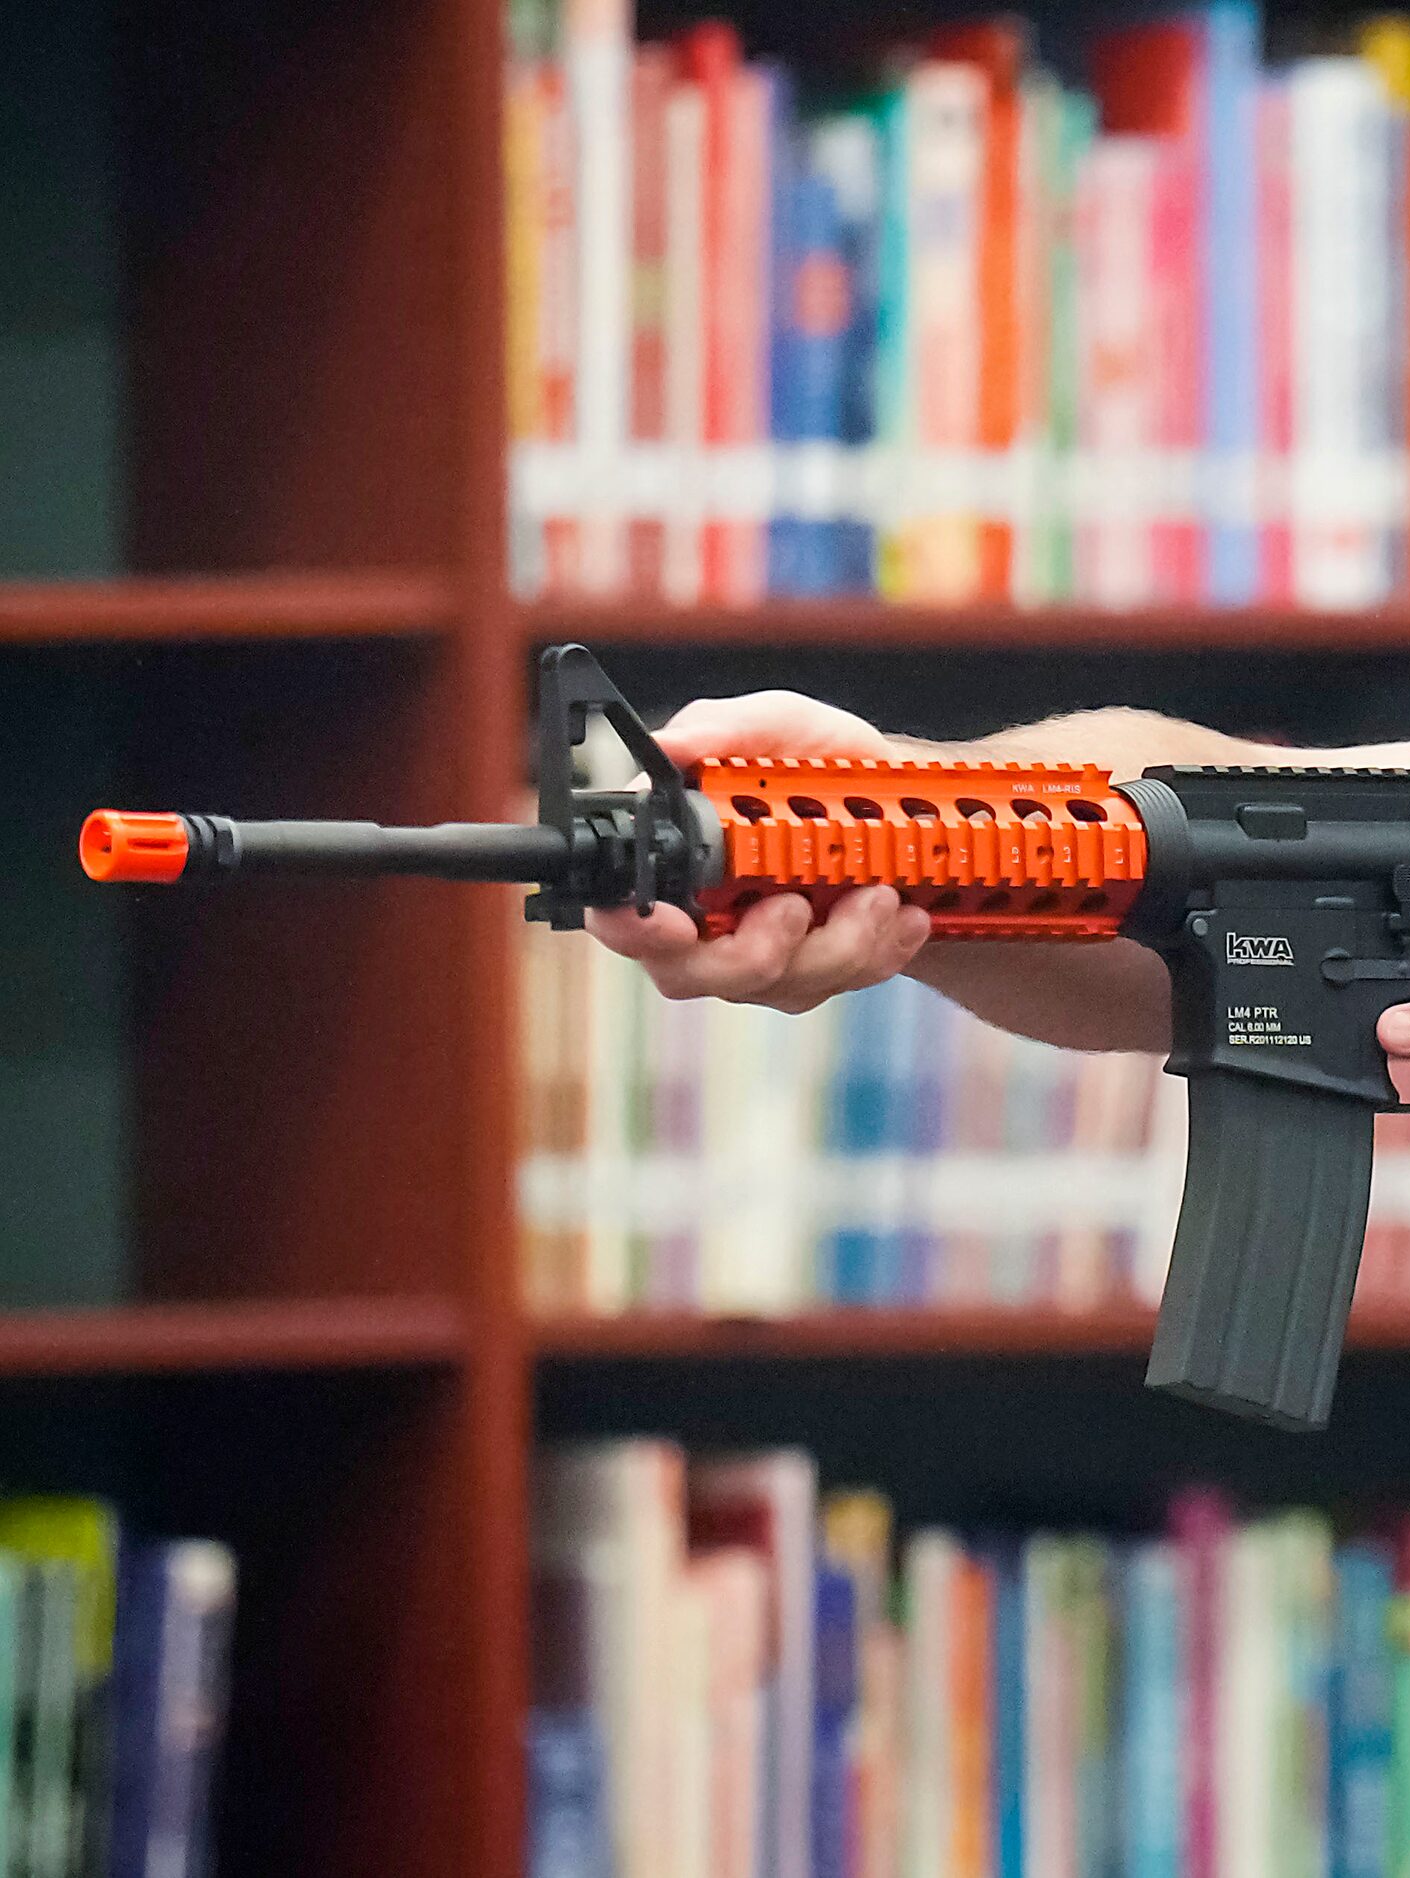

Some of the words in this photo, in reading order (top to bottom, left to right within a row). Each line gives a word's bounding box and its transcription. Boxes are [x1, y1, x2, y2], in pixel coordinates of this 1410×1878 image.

[1011, 783, 1035, 793] KWA
[1228, 1006, 1251, 1018] LM4
[1254, 1006, 1279, 1018] PTR
[1228, 1022, 1246, 1032] CAL
